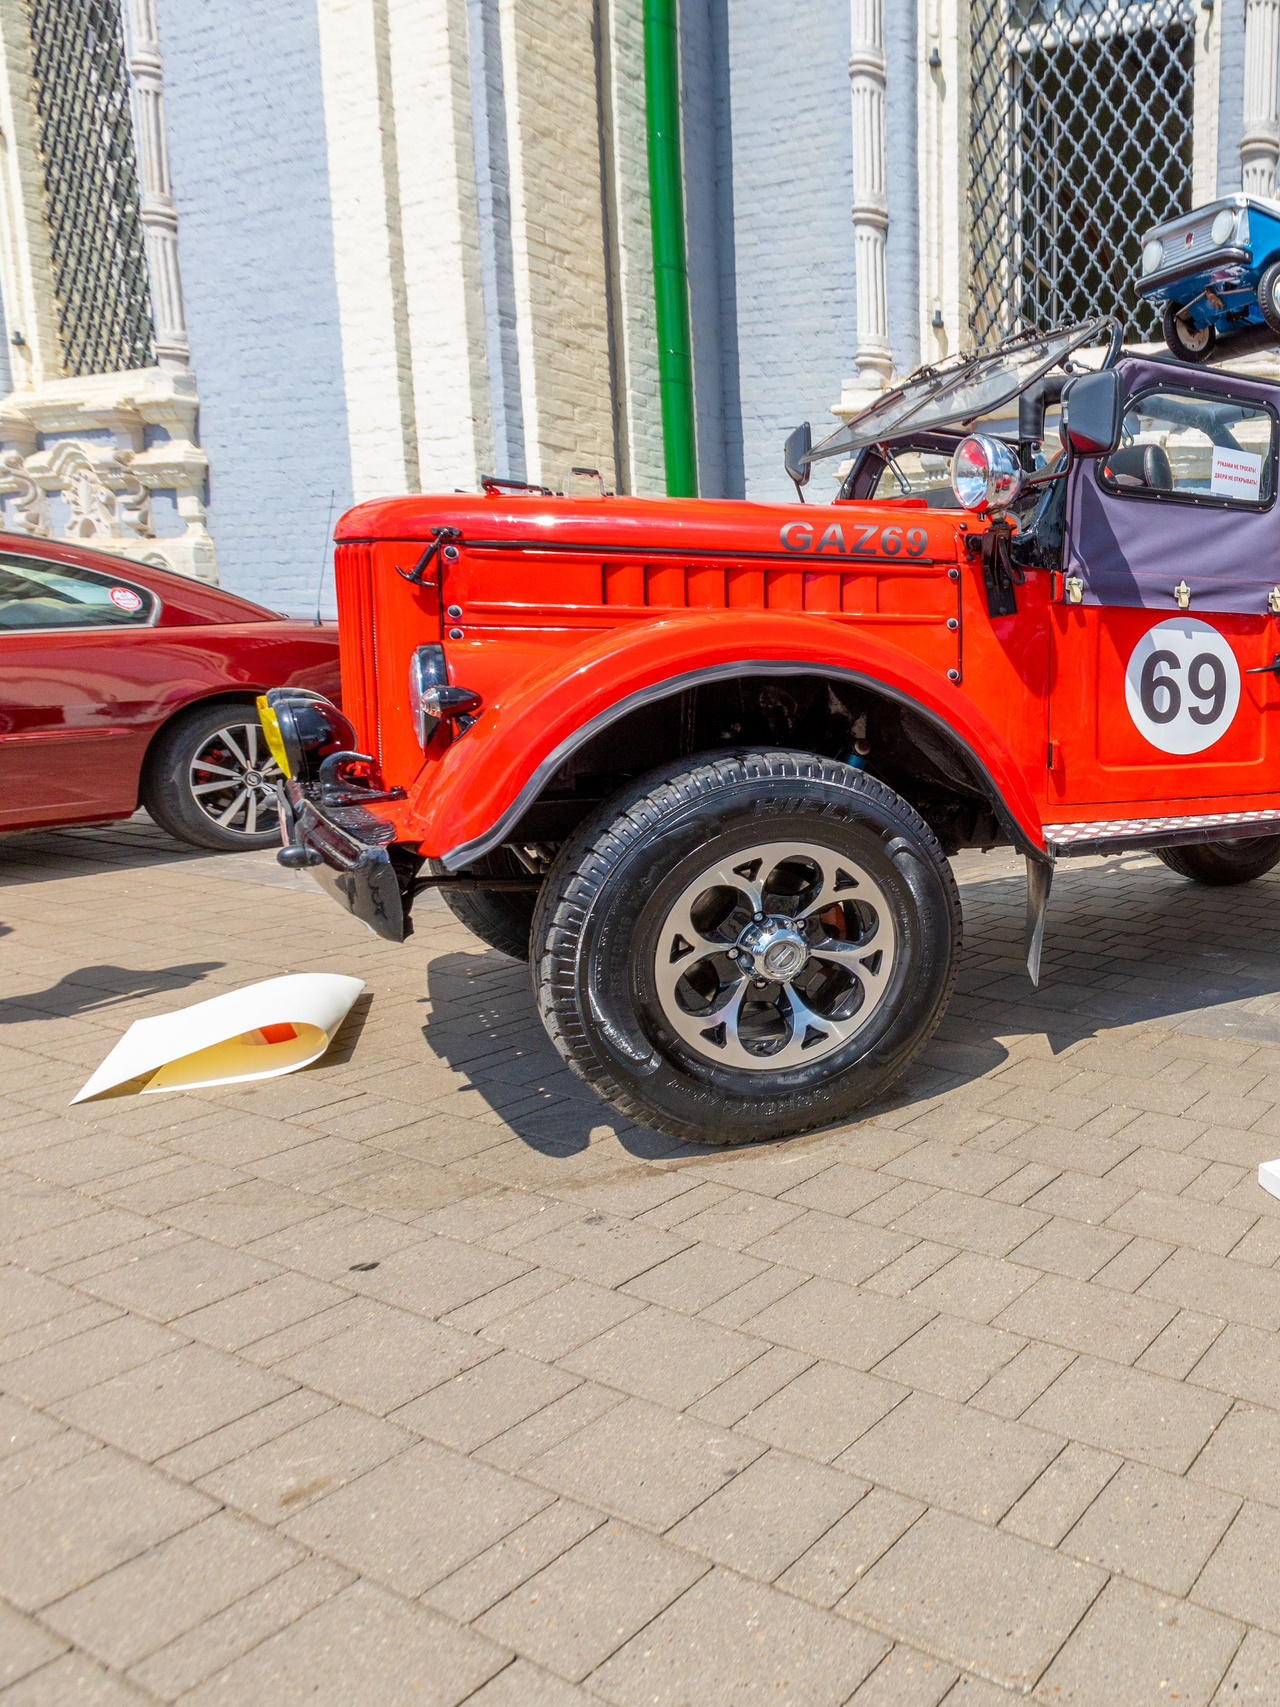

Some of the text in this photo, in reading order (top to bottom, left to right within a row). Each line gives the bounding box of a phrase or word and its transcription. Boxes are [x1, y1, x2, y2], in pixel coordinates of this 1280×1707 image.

[779, 521, 928, 557] GAZ69
[1140, 649, 1227, 726] 69
[753, 797, 871, 824] HIFLY
